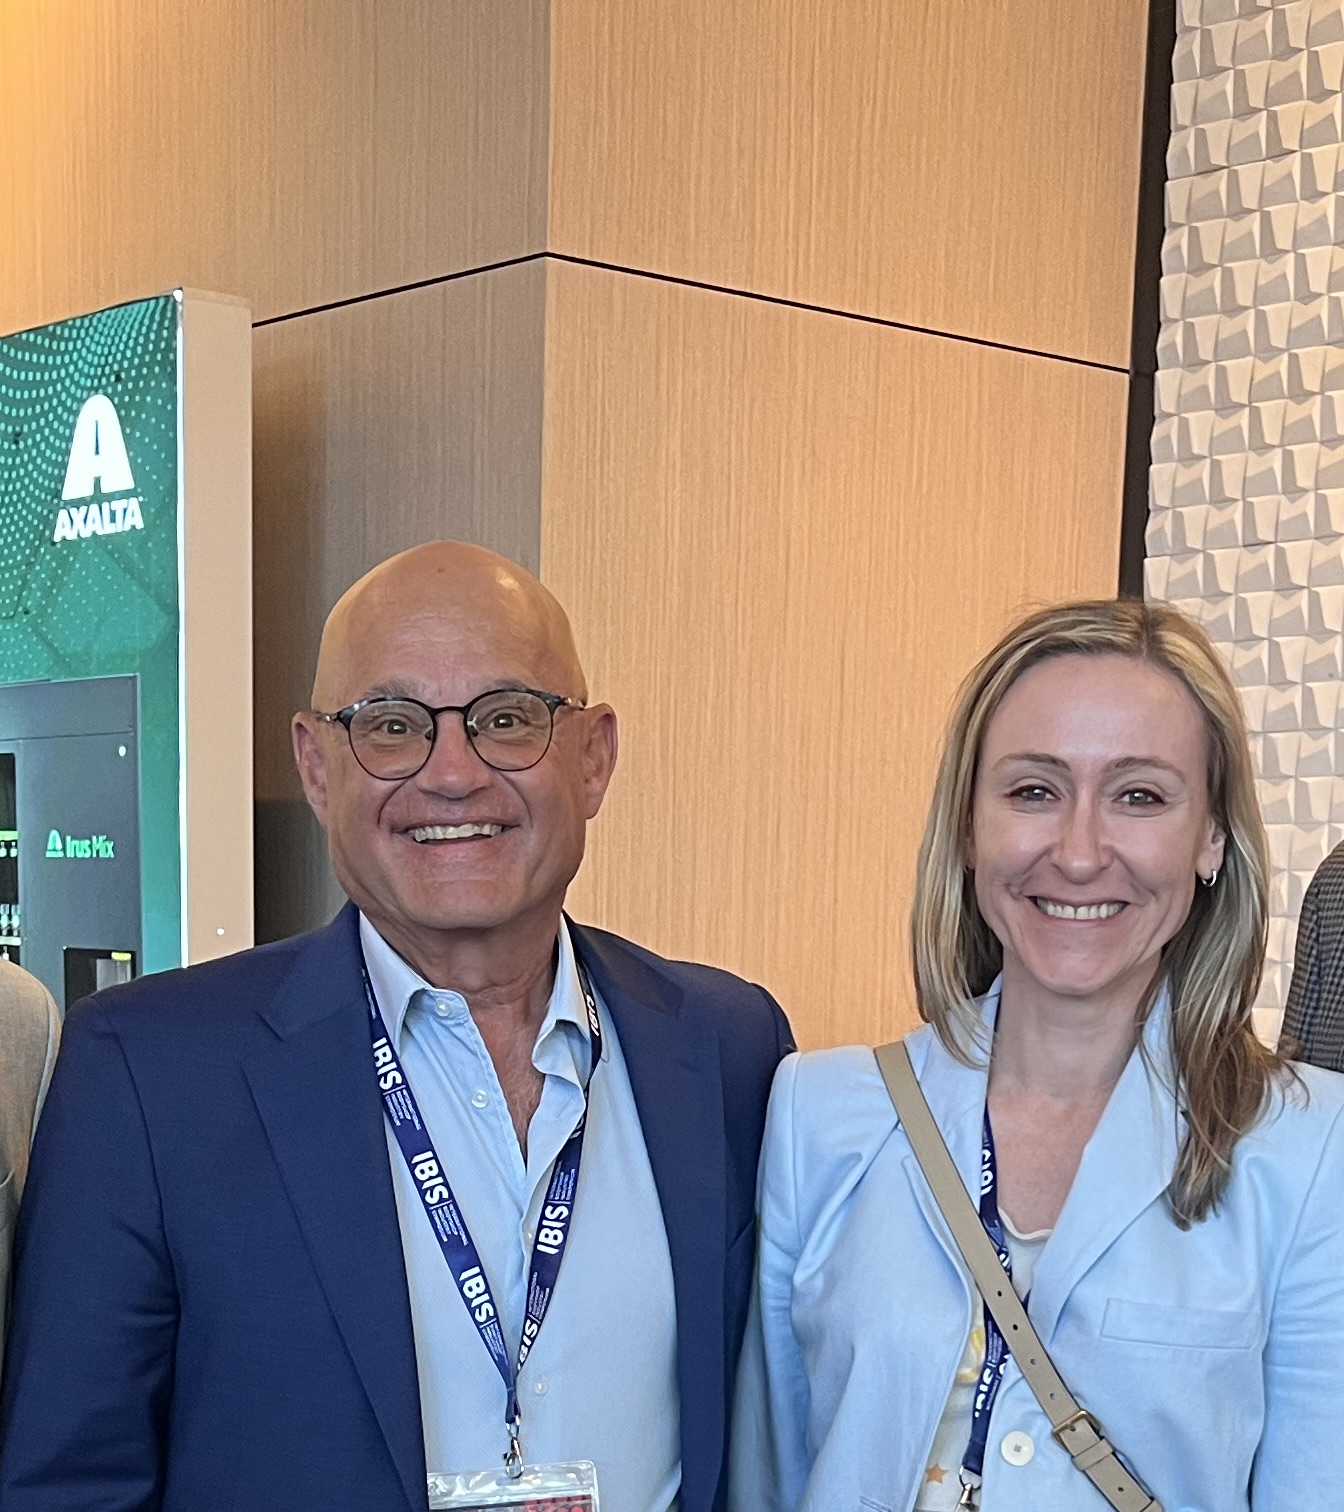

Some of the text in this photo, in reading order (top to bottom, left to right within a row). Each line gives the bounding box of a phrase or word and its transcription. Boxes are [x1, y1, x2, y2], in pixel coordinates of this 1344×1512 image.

[53, 497, 144, 543] AXALTA
[411, 1150, 449, 1205] IBIS
[536, 1205, 569, 1255] IBIS
[459, 1265, 494, 1322] IBIS
